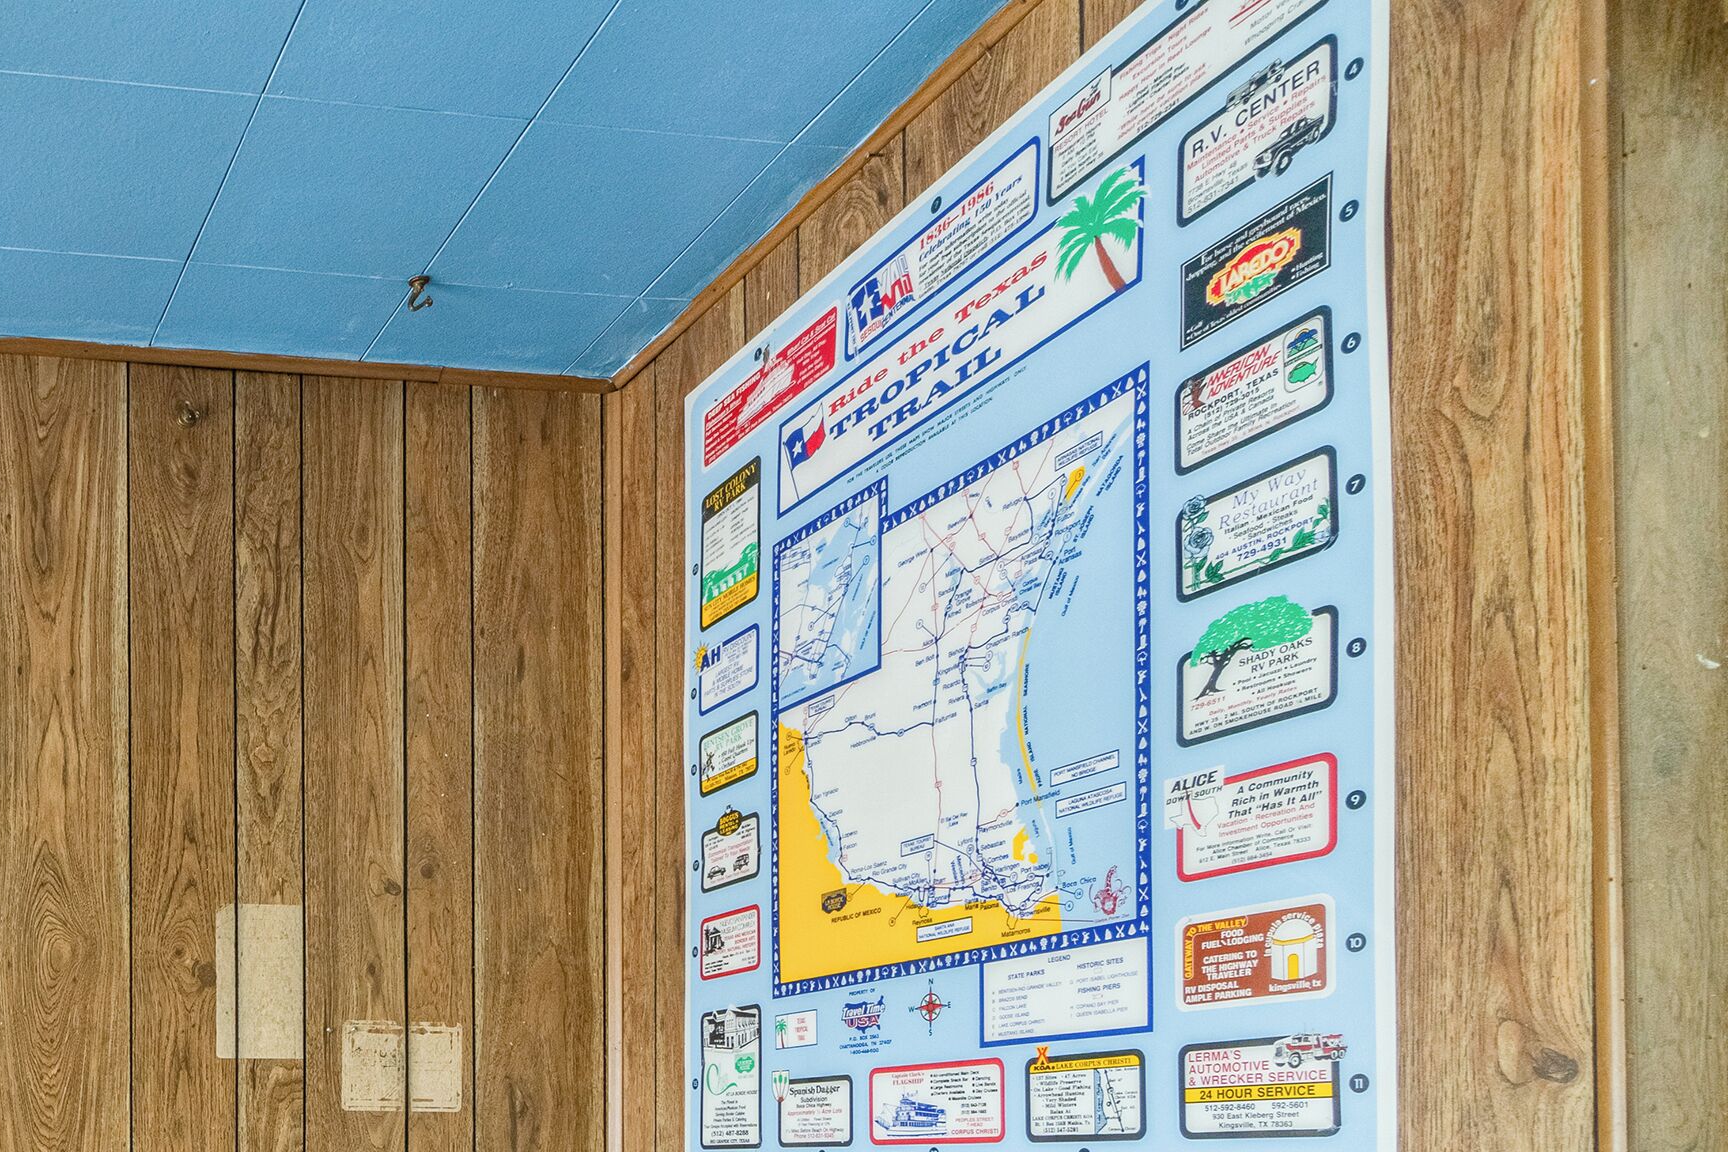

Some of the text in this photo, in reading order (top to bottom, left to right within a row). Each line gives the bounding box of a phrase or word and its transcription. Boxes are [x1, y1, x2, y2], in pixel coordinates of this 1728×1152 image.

[1193, 125, 1227, 158] R.V.
[1236, 61, 1319, 127] CENTER
[1187, 75, 1326, 170] Maintenance Service Repairs
[919, 175, 1023, 262] Celebrating 150 Years
[1219, 240, 1289, 294] LAREDO
[829, 251, 1047, 416] Ride the Texas
[829, 285, 1046, 440] TROPICAL
[1207, 344, 1271, 388] AMERICAN
[1207, 351, 1280, 399] ADVENTURE
[723, 393, 734, 407] SEA
[868, 348, 1002, 441] TRAIL
[1188, 369, 1278, 420] ROCKPORT, TEXAS
[706, 464, 757, 508] LOST COLONY
[1233, 470, 1306, 509] My Way
[714, 484, 746, 511] RV PARK
[1219, 479, 1318, 529] Restaurant
[1224, 495, 1313, 534] Italian Mexican Food
[1233, 510, 1298, 539] Seafood Steaks
[1247, 519, 1293, 538] Sandwiches
[1215, 517, 1314, 560] 404 AUSTIN, ROCKPORT
[1237, 537, 1288, 561] 729-4931
[700, 646, 721, 673] AH
[1239, 638, 1312, 667] SHADY OAKS
[1251, 652, 1299, 673] RV PARK
[1171, 770, 1218, 793] ALICE
[1237, 770, 1313, 794] A Community
[1035, 789, 1061, 803] Mansfield
[1194, 786, 1222, 798] SOUTH
[1232, 781, 1319, 807] Rich in Warmth
[1217, 802, 1315, 829] Vacation Recreation And
[1228, 806, 1252, 819] That
[1287, 795, 1296, 805] It
[1219, 813, 1313, 837] Investment Opportunities
[831, 914, 849, 923] REPUBLIC
[863, 908, 881, 916] MEXICO
[1282, 912, 1315, 926] service
[1186, 927, 1197, 936] TO
[1198, 923, 1212, 932] THE
[1215, 919, 1247, 929] VALLEY
[1221, 929, 1244, 938] FOOD
[1349, 938, 1362, 947] 10
[1048, 955, 1070, 963] LEGEND
[1203, 950, 1257, 964] CATERING TO
[1008, 969, 1044, 980] STATE PARKS
[1202, 960, 1258, 974] THE HIGHWAY
[1206, 969, 1251, 980] TRAVELER
[1077, 986, 1100, 994] FISHING
[1185, 981, 1238, 994] RV DISPOSAL
[1185, 989, 1251, 1003] AMPLE PARKING
[842, 1003, 885, 1018] Travel Time
[846, 1017, 879, 1028] USA
[1075, 1060, 1101, 1068] CORPUS
[1188, 1050, 1241, 1062] LERMA'S
[1189, 1061, 1269, 1074] AUTOMOTIVE
[1189, 1070, 1327, 1086] & WRECKER SERVICE
[1354, 1079, 1363, 1088] 11
[790, 1085, 840, 1096] Spanish Dagger
[1200, 1085, 1316, 1100] 24 HOUR SERVICE
[1205, 1103, 1256, 1111] 512-592-8460
[1246, 1112, 1273, 1121] Kleberg
